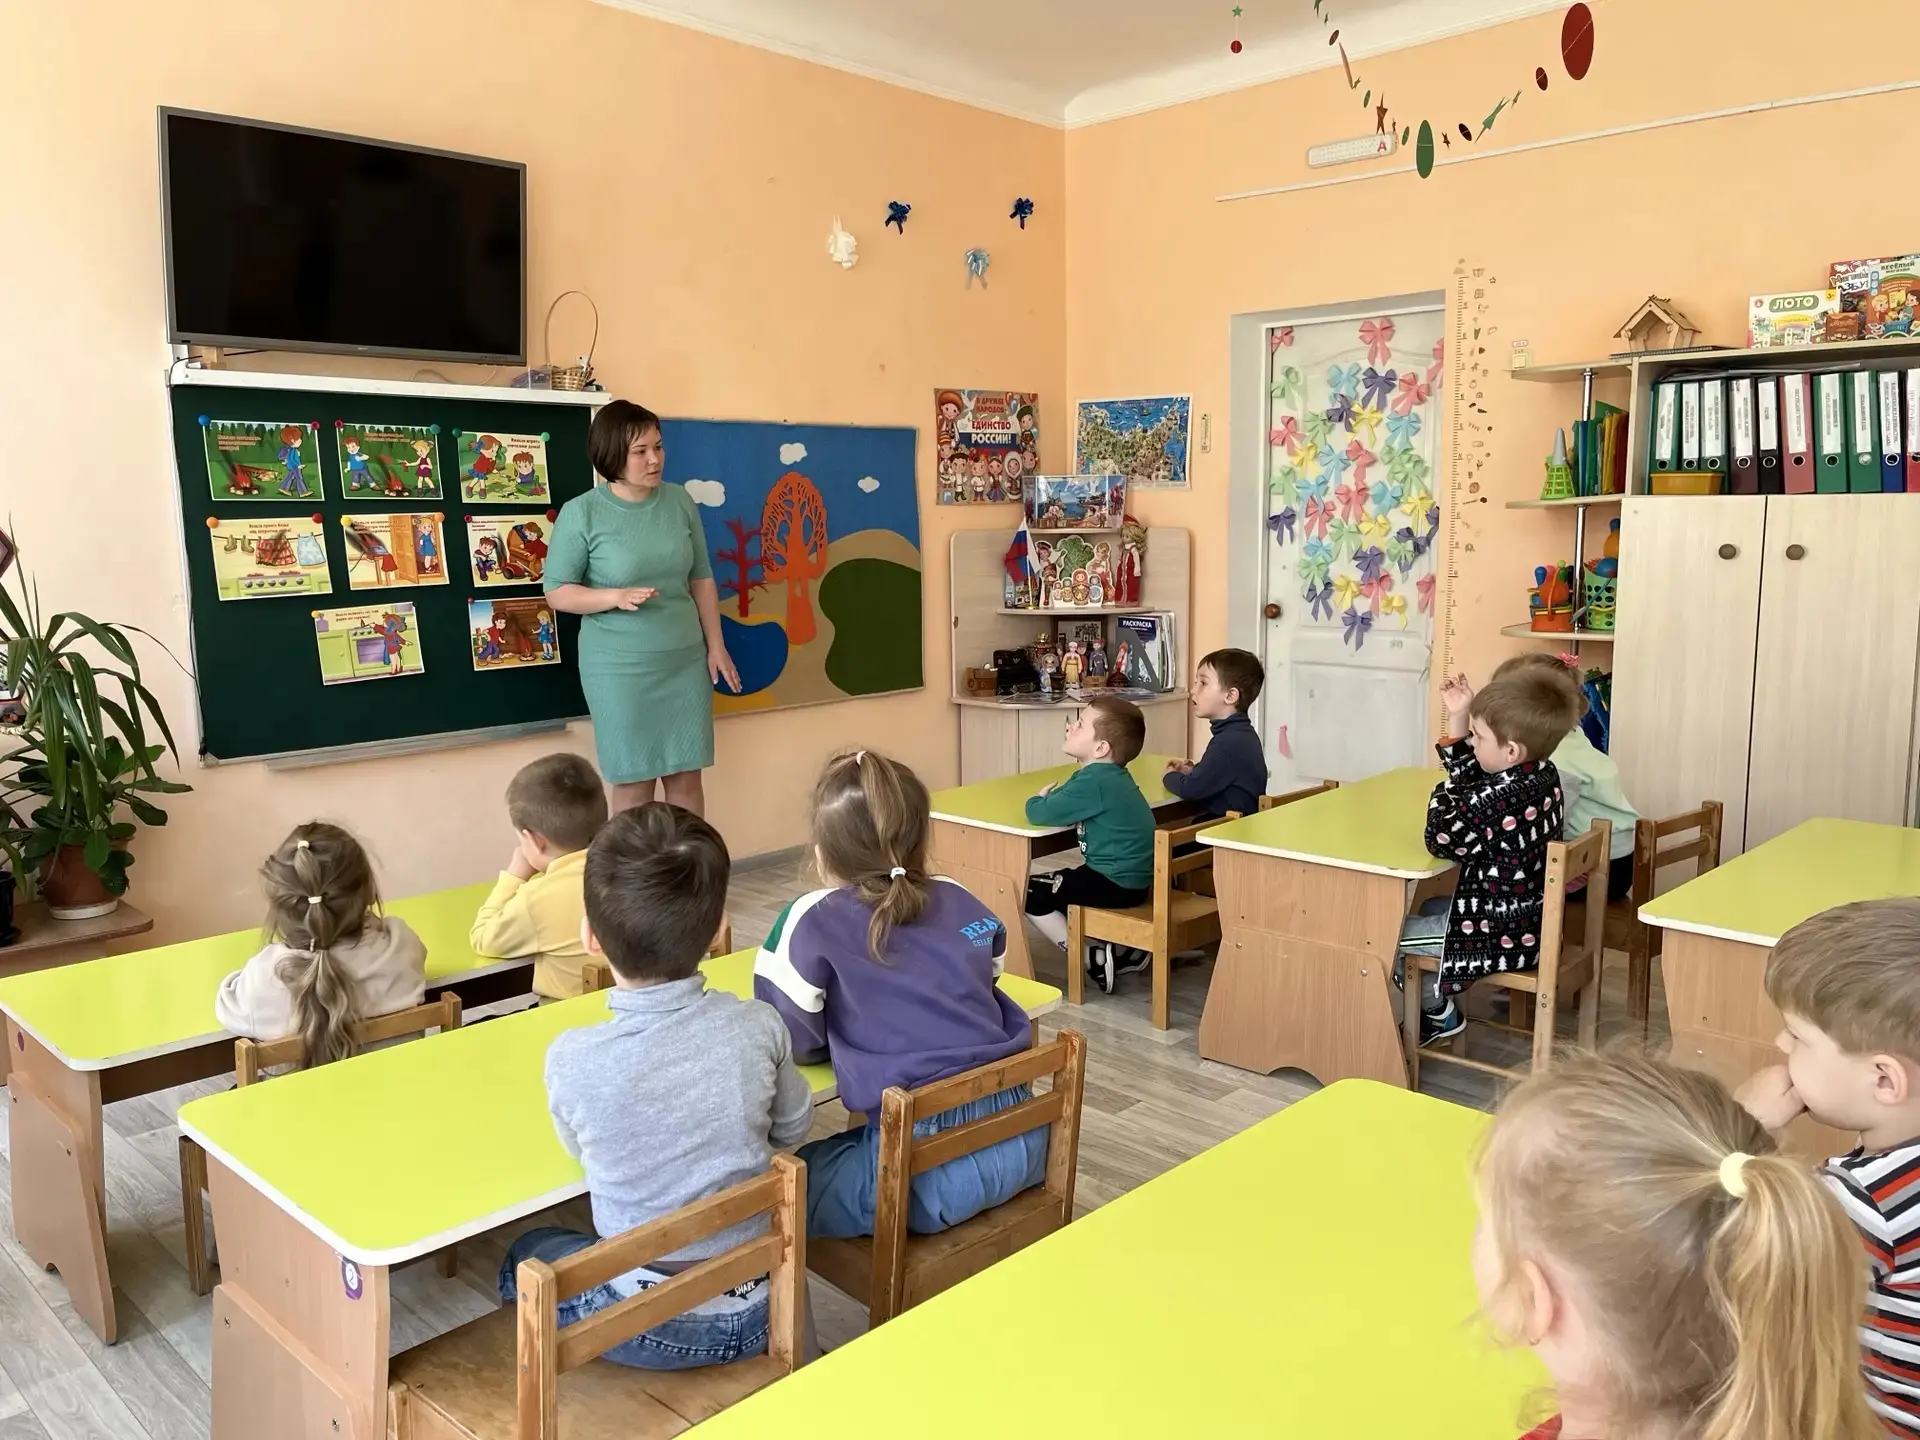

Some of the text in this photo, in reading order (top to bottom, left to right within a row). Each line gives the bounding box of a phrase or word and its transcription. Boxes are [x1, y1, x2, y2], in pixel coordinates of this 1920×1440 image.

[1773, 297, 1814, 310] ЛОТО
[972, 421, 1011, 431] ЕДИНСТВО
[971, 433, 1012, 444] РОССИИ!
[1122, 620, 1152, 628] РАСКРАСКА
